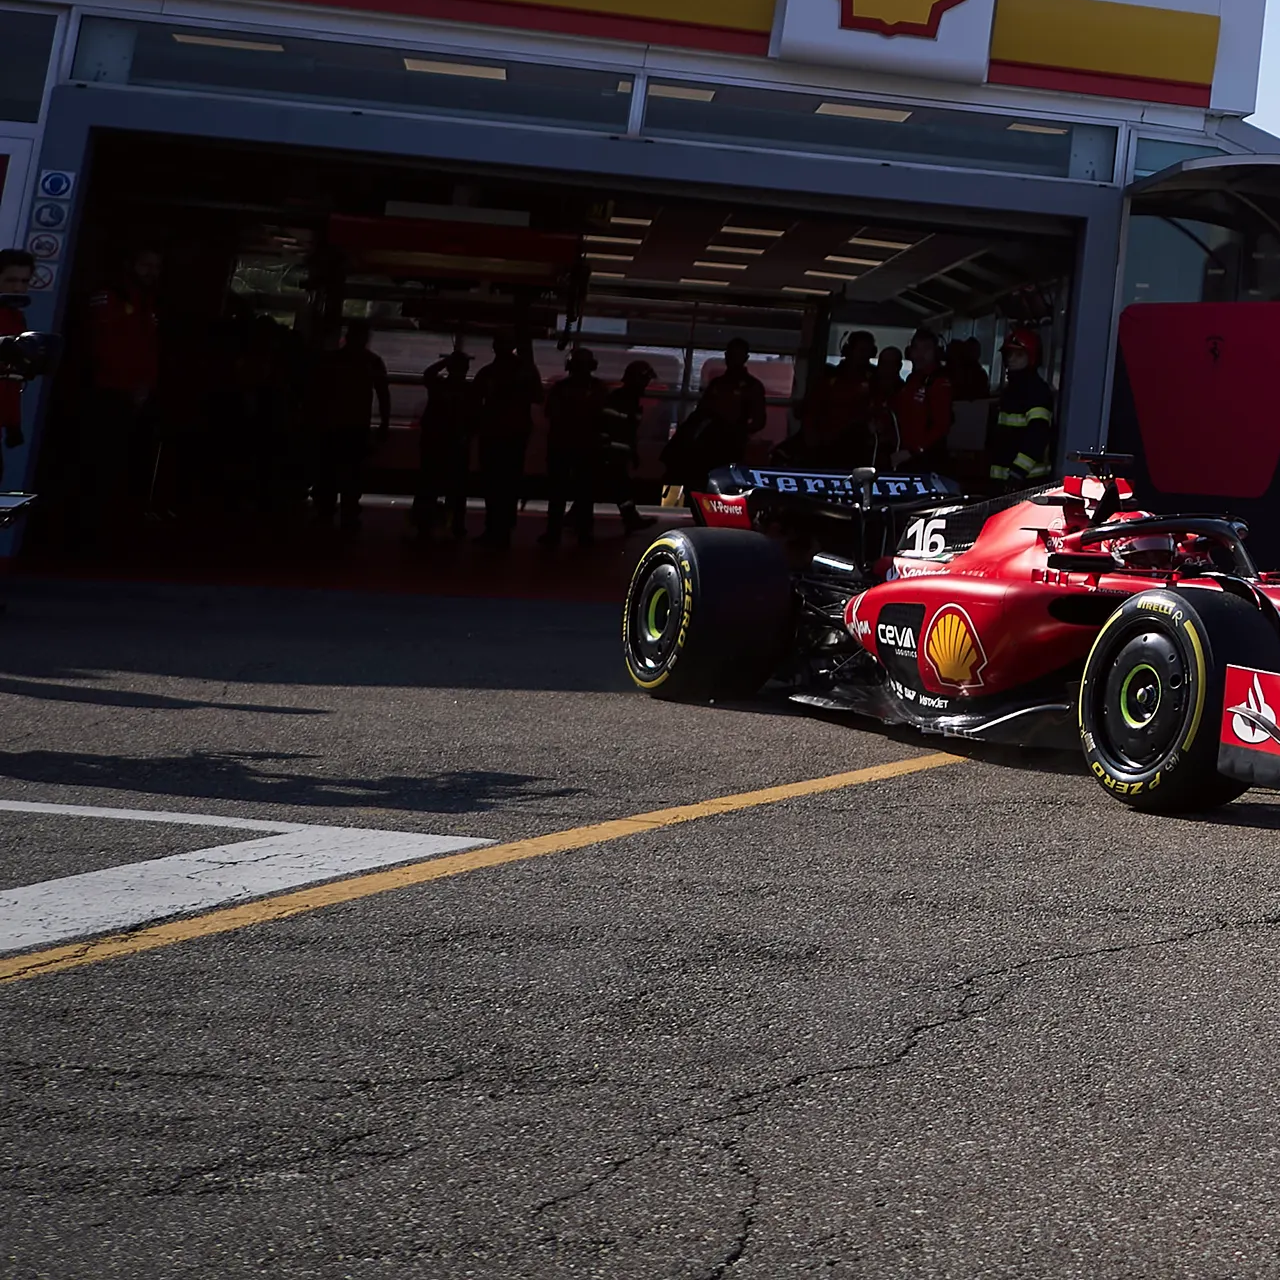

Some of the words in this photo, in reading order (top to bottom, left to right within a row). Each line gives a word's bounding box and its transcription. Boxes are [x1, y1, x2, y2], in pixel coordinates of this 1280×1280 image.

[709, 500, 743, 516] V-Power
[907, 518, 947, 558] 16
[677, 578, 692, 648] ZERO
[1137, 596, 1177, 616] PIRELLI
[1091, 761, 1144, 795] ZERO
